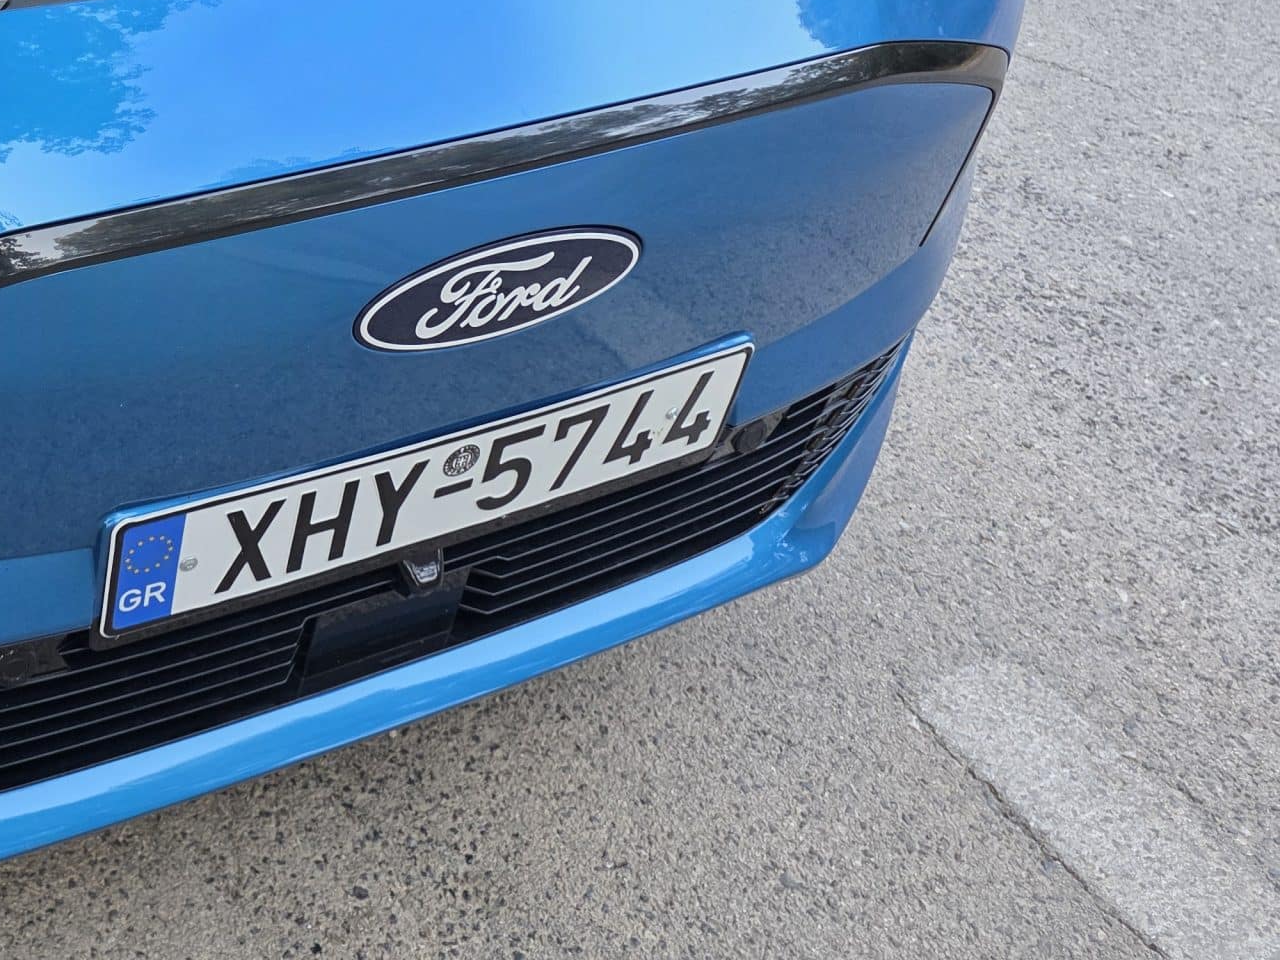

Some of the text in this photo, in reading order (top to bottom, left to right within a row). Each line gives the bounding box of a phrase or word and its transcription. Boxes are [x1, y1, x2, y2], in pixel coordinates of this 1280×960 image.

[415, 251, 594, 339] Ford
[214, 371, 714, 594] XHY-5744
[118, 581, 167, 612] GR
